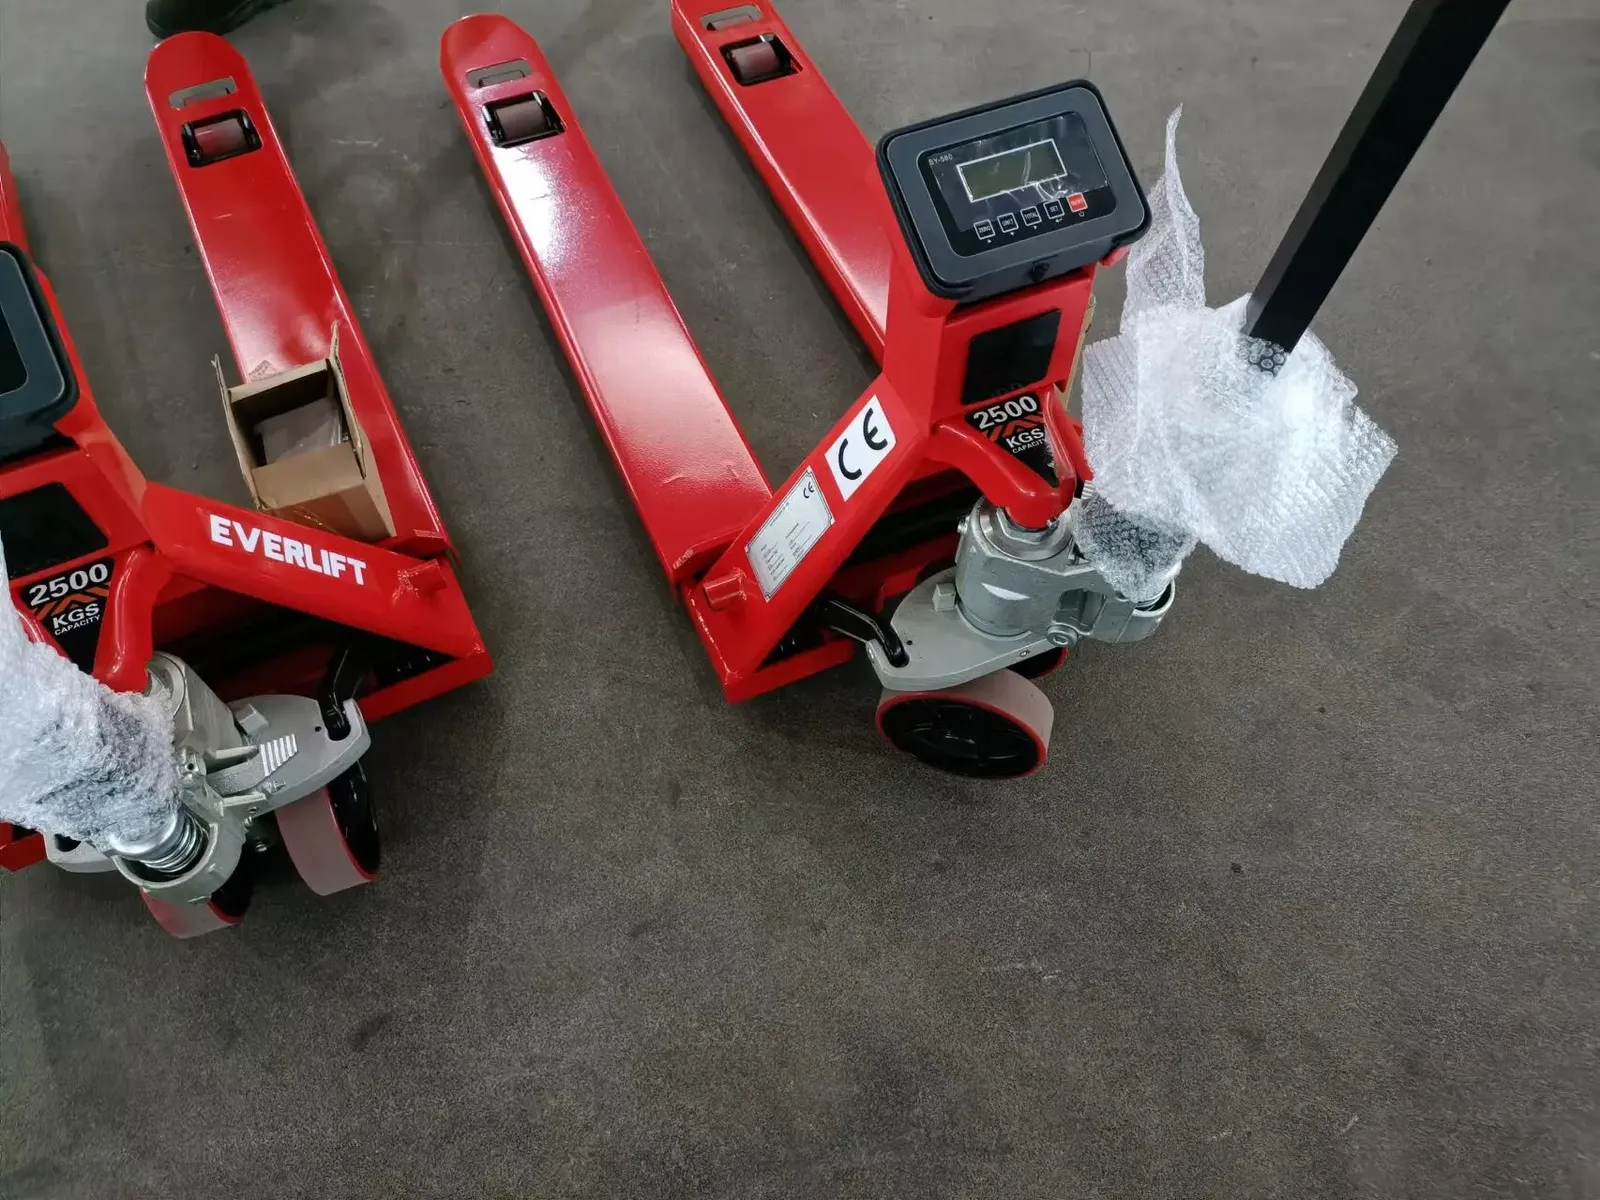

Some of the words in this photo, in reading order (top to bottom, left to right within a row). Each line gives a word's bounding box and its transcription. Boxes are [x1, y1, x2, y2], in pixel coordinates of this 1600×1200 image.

[973, 396, 1038, 430] 2500
[838, 407, 888, 481] CE
[1006, 428, 1044, 448] KGS
[1012, 438, 1046, 454] CAPACITY
[209, 514, 366, 585] EVERLIFT
[28, 563, 108, 607] 2500
[52, 602, 100, 629] KGS
[54, 614, 101, 636] CAPACITY
